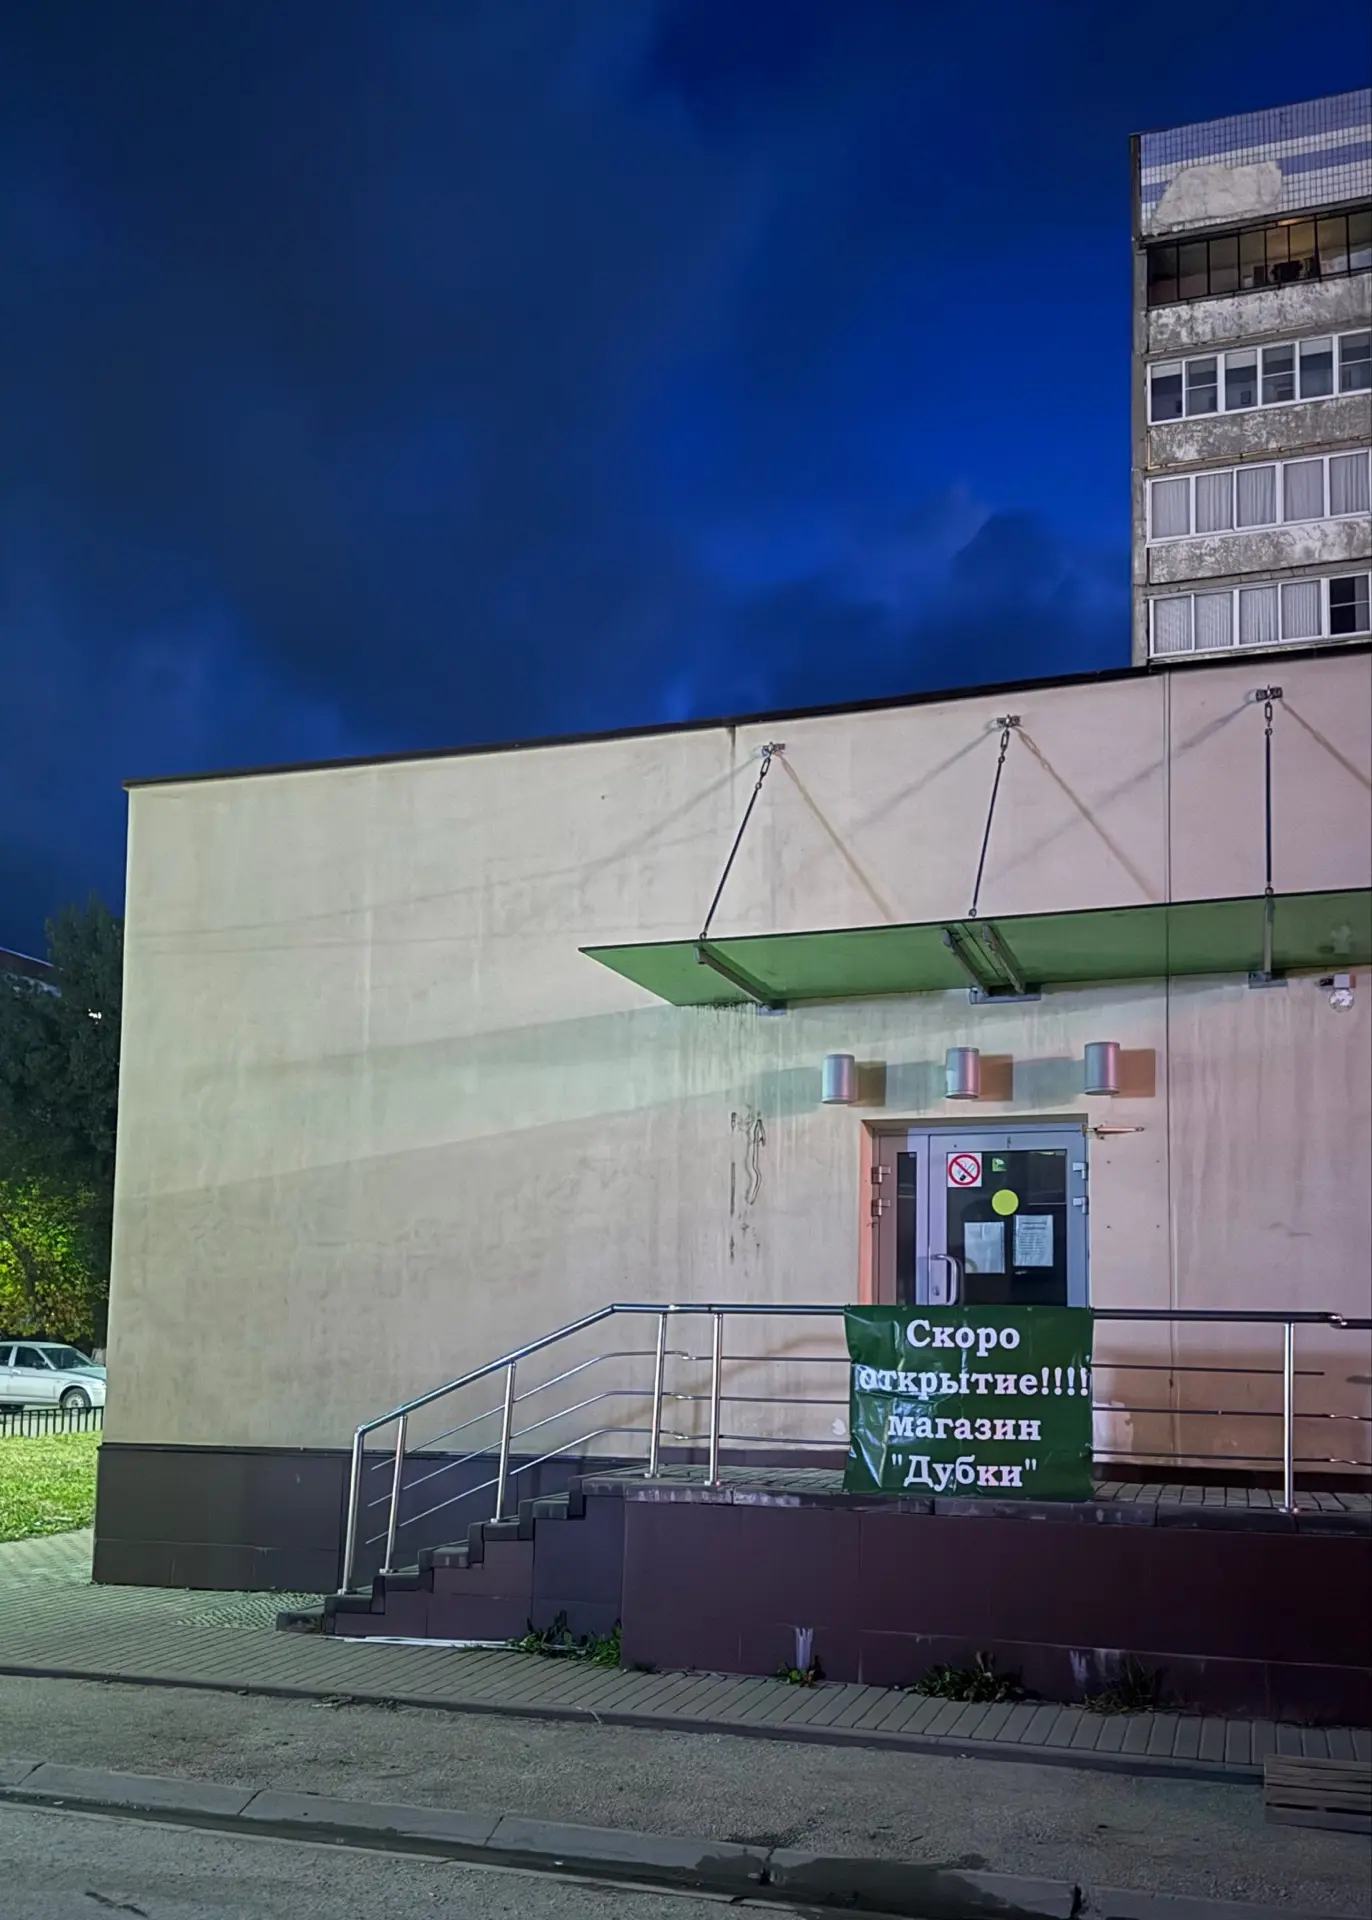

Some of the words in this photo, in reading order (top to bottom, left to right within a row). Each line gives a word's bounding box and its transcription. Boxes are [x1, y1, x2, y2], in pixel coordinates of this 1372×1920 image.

[906, 1319, 1020, 1357] Скоро
[858, 1366, 1090, 1400] открытие!!!!
[887, 1415, 1042, 1441] магазин
[891, 1453, 1037, 1492] "Дубки"
